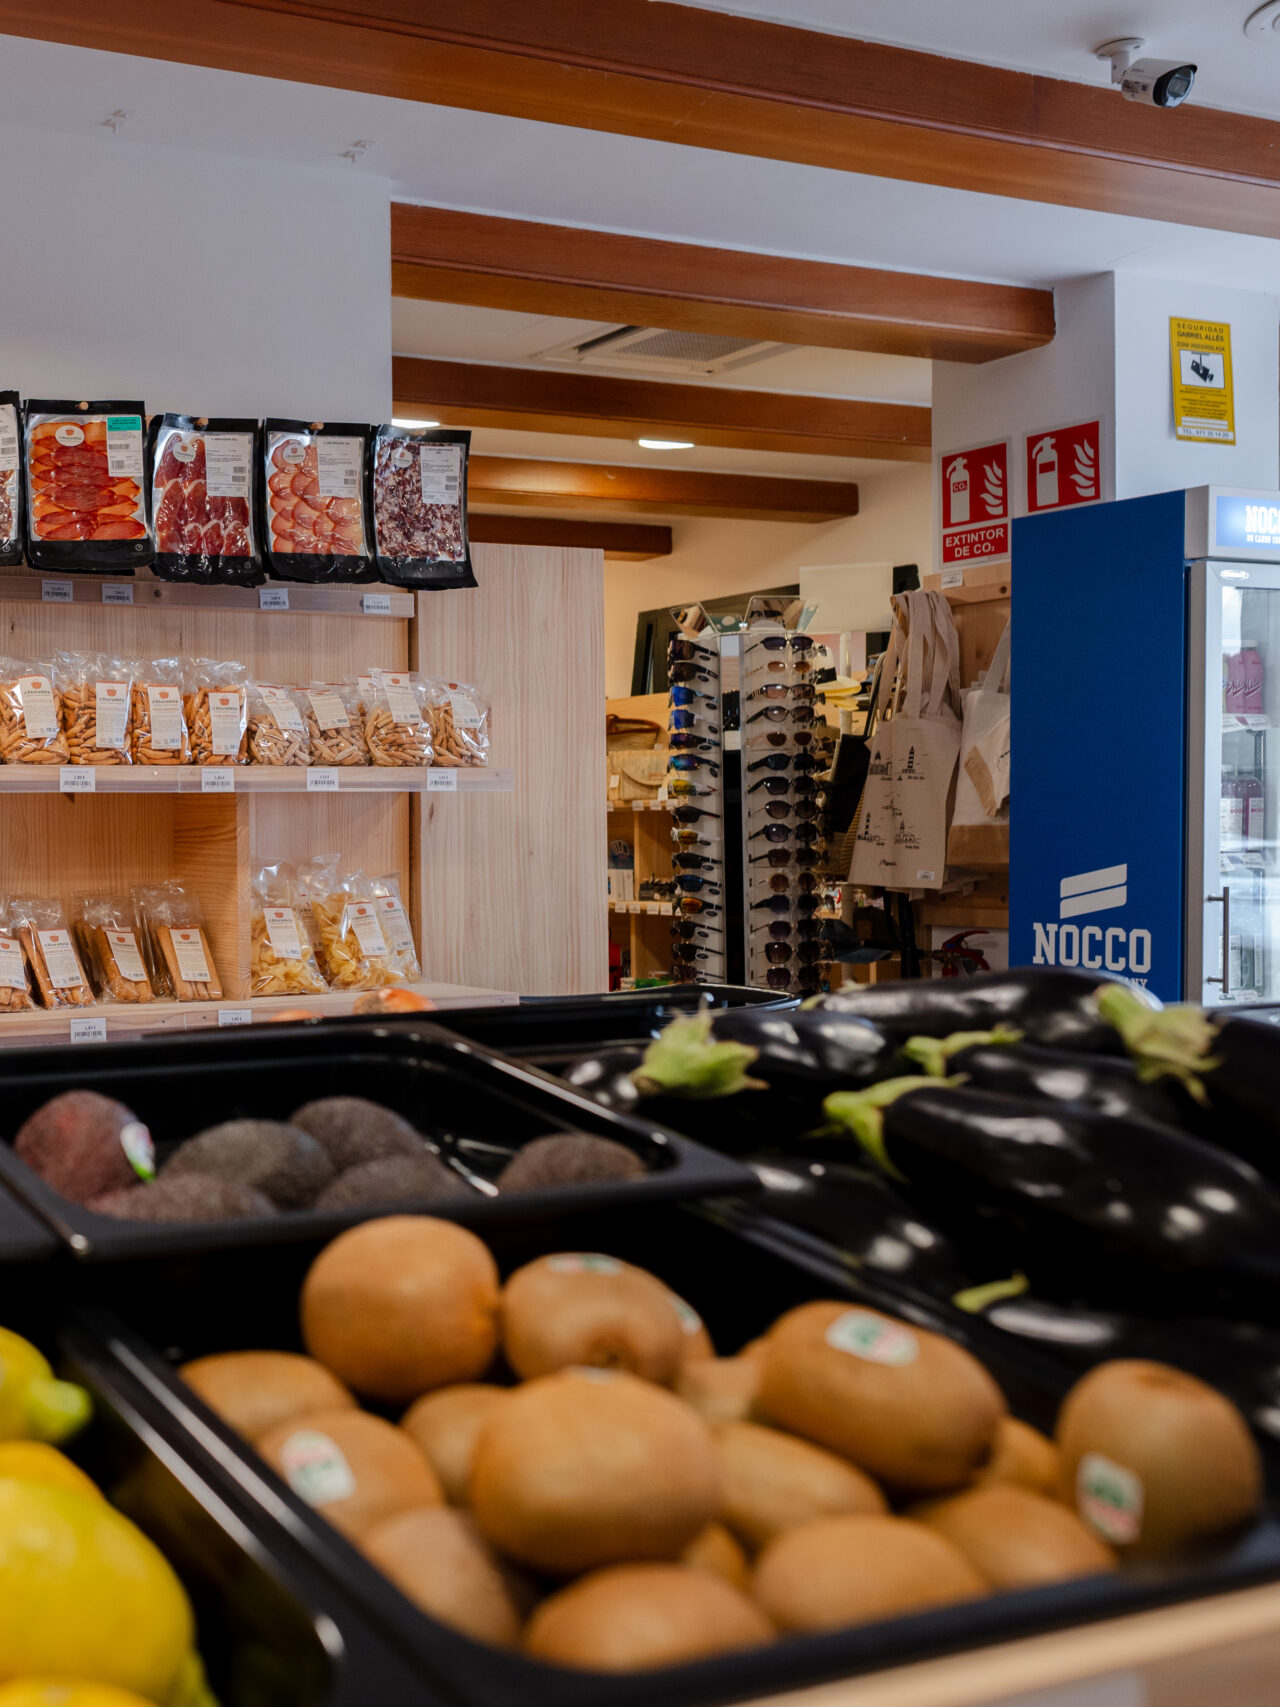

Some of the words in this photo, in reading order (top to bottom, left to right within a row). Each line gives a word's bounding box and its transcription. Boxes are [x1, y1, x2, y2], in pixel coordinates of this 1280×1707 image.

[1176, 322, 1224, 333] SEGURIDAD
[1176, 331, 1203, 340] GABRIEL
[1245, 505, 1280, 535] NOC
[945, 527, 1005, 548] EXTINTOR
[954, 545, 971, 558] DE
[1032, 922, 1152, 974] NOCCO
